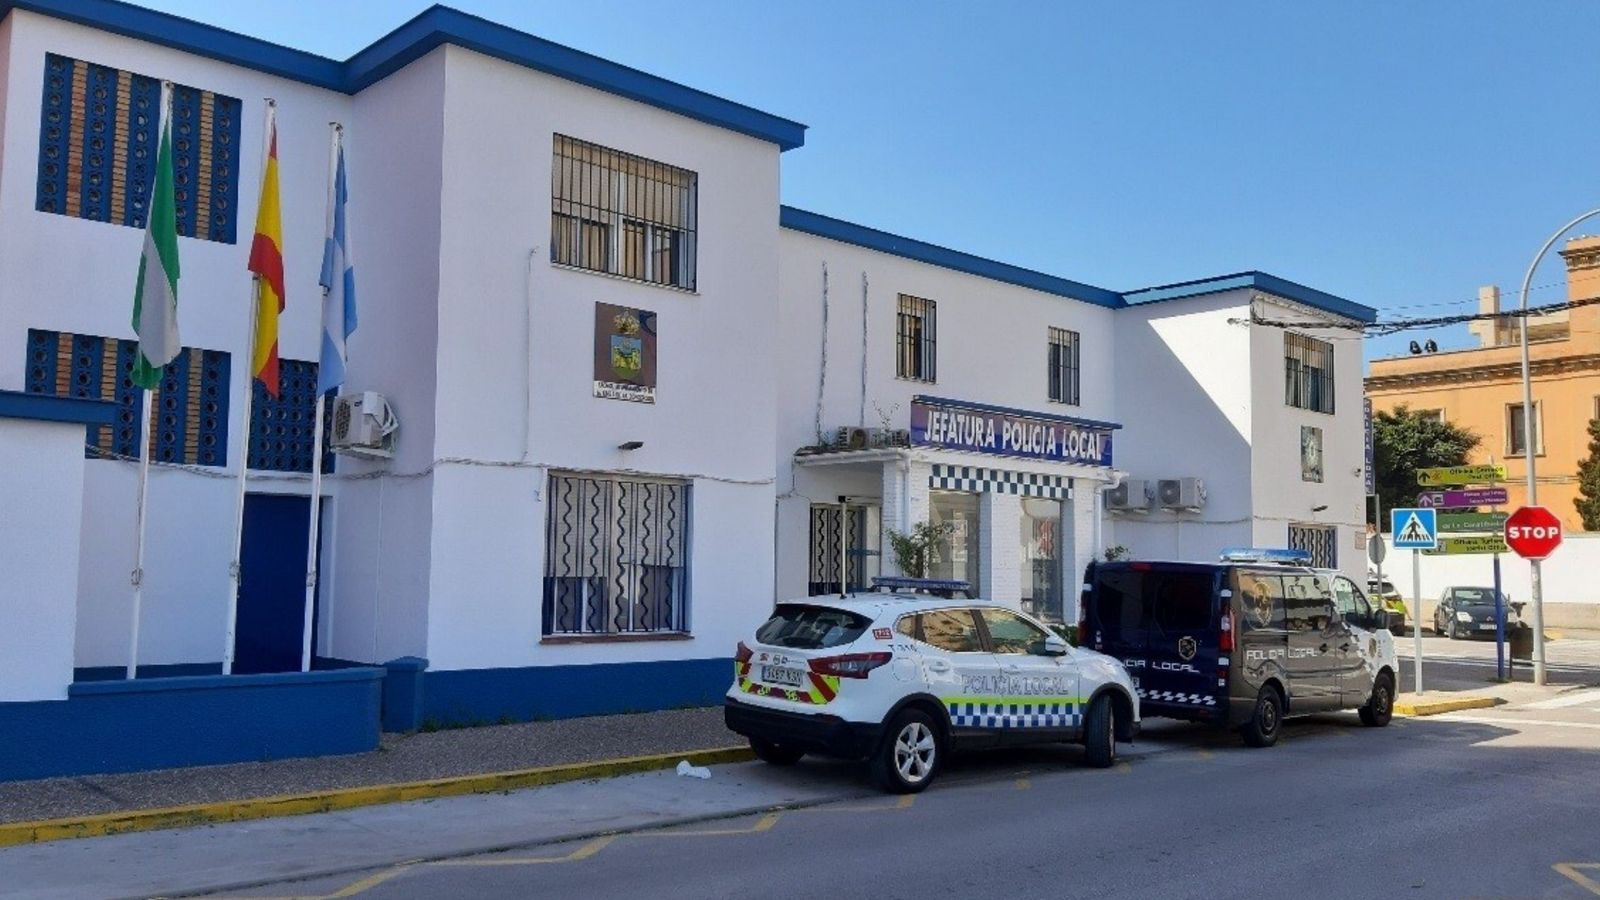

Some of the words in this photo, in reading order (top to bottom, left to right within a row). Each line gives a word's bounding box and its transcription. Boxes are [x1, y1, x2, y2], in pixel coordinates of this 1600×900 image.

[924, 410, 995, 449] JEFATURA
[1002, 420, 1056, 455] POLICIA
[1062, 428, 1101, 461] LOCAL
[1509, 527, 1559, 539] STOP
[1152, 661, 1200, 673] LOCAL
[1023, 676, 1069, 696] LOCAL
